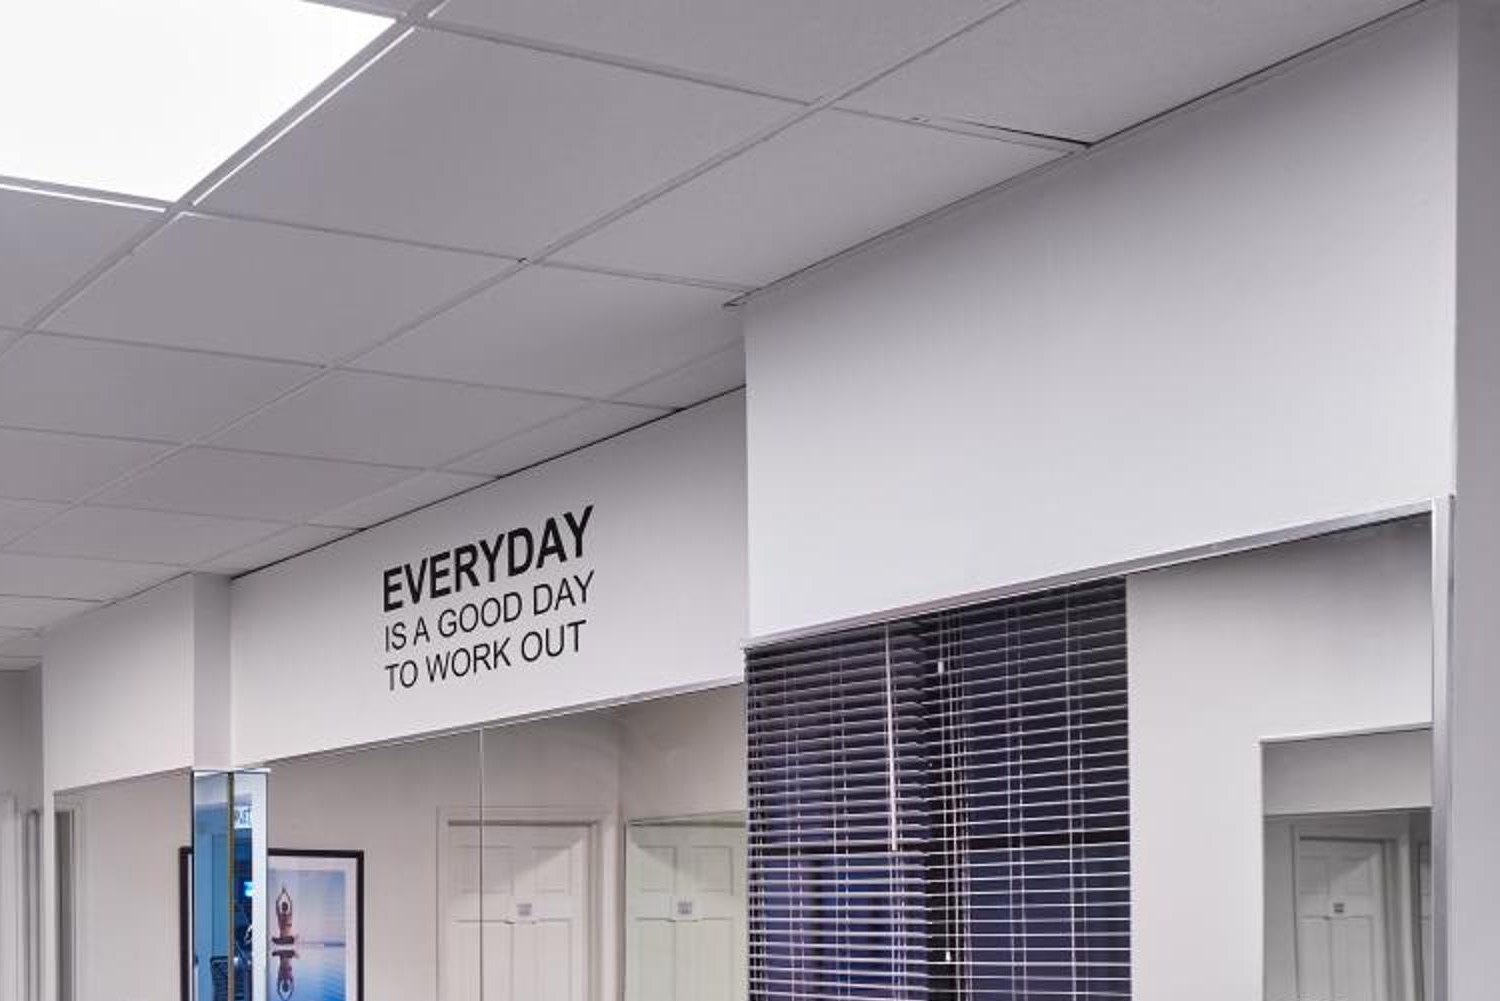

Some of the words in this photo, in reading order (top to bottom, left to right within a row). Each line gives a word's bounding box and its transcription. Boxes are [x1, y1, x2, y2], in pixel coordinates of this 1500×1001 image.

[383, 504, 594, 613] EVERYDAY
[385, 621, 407, 652] IS
[413, 616, 430, 646] A
[437, 591, 522, 638] GOOD
[533, 569, 594, 616] DAY
[384, 659, 418, 691] TO
[426, 637, 512, 682] WORK
[521, 619, 587, 663] OUT
